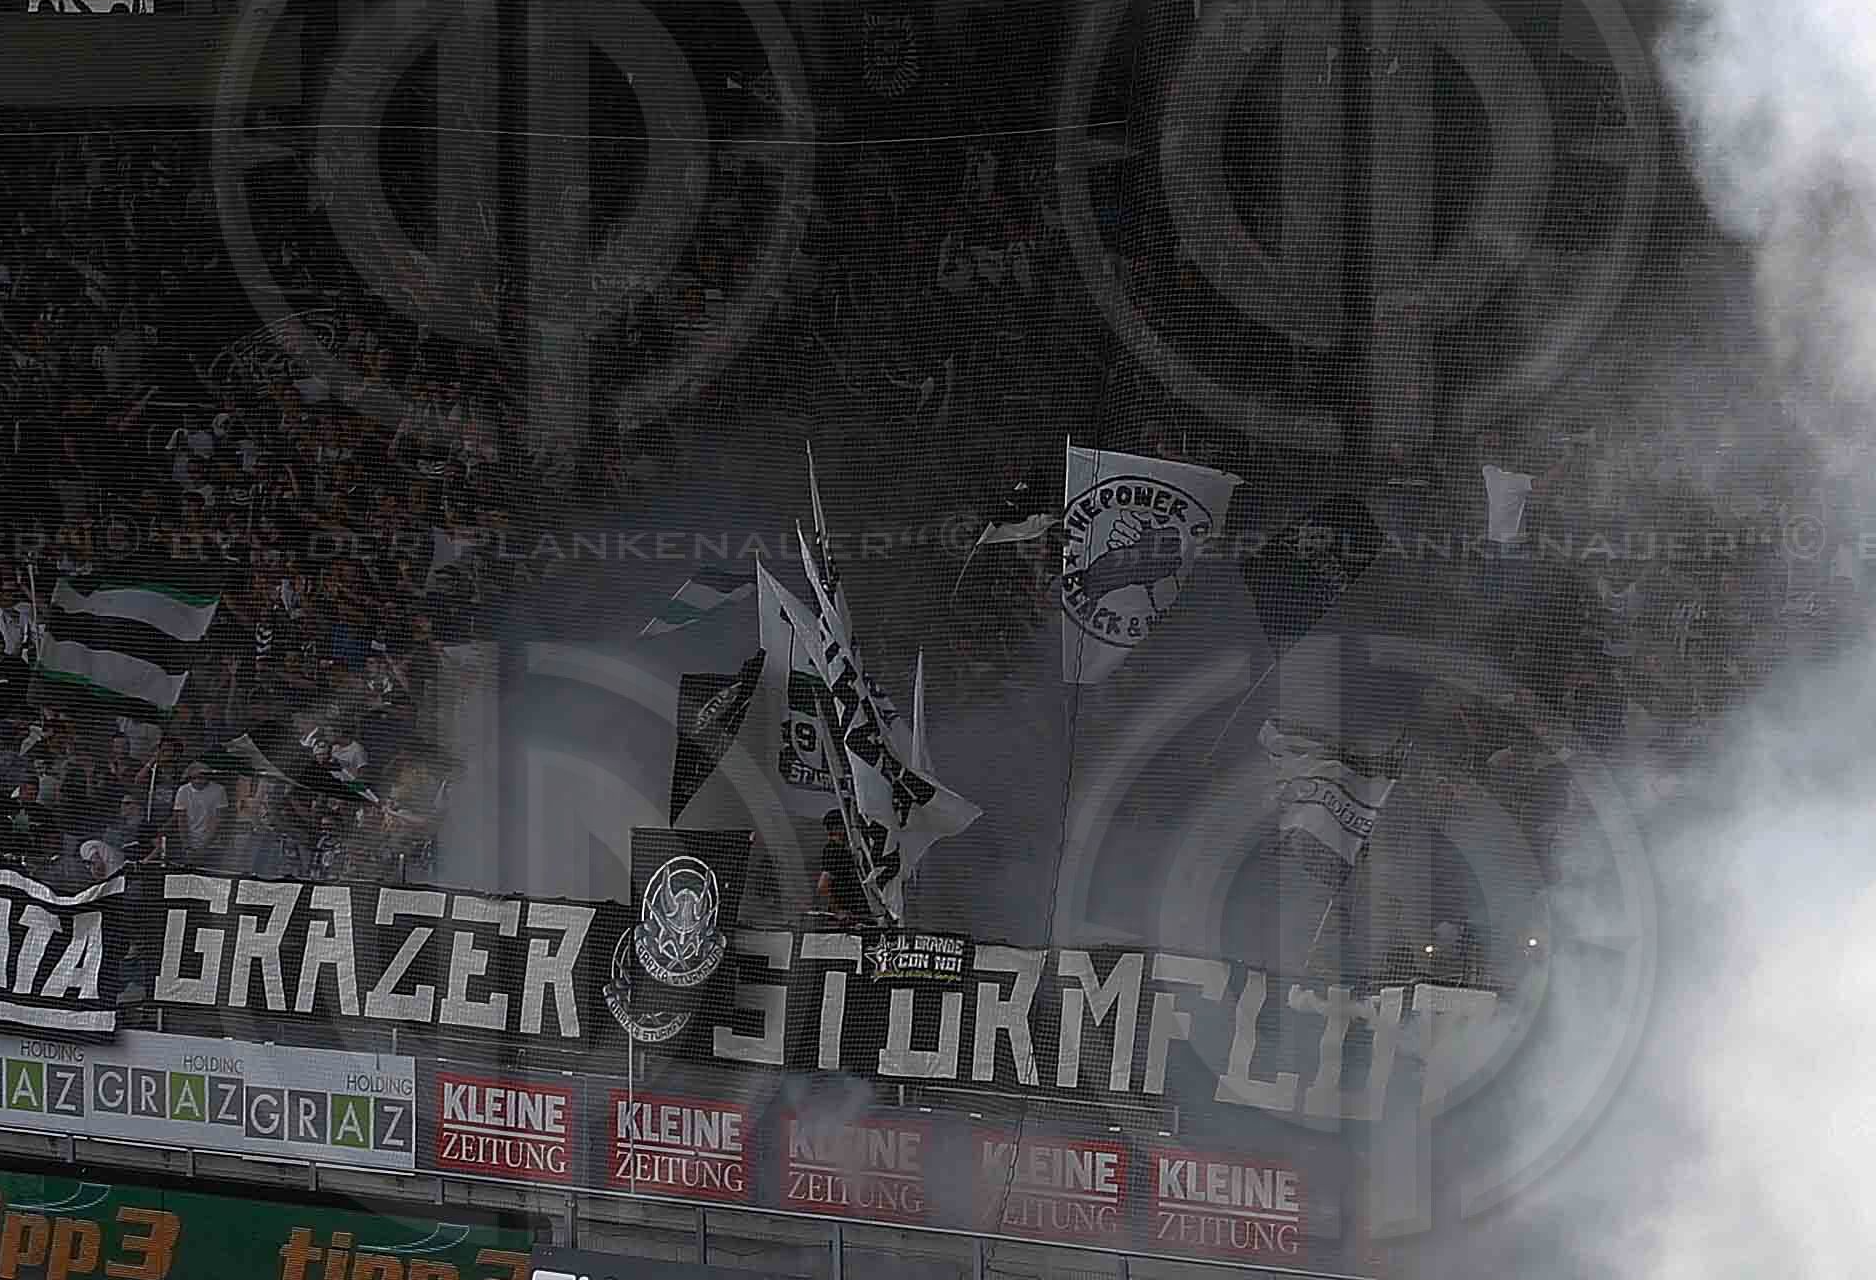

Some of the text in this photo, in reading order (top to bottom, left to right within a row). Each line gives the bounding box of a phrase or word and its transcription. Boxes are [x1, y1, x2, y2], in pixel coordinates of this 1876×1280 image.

[1100, 486, 1189, 523] POWER
[155, 874, 596, 1038] GRAZER
[899, 953, 962, 973] CON NOI
[20, 1040, 85, 1062] HOLDING
[182, 1053, 244, 1074] HOLDING
[97, 1070, 239, 1119] GRAZ
[346, 1073, 413, 1096] HOLDING
[251, 1093, 405, 1147] GRAZ
[444, 1082, 567, 1134] KLEINE
[617, 1099, 743, 1152] KLEINE
[442, 1133, 566, 1174] ZEITUNG
[615, 1151, 743, 1193] ZEITUNG
[1159, 1157, 1300, 1212] KLEINE
[1157, 1211, 1299, 1255] ZEITUNG
